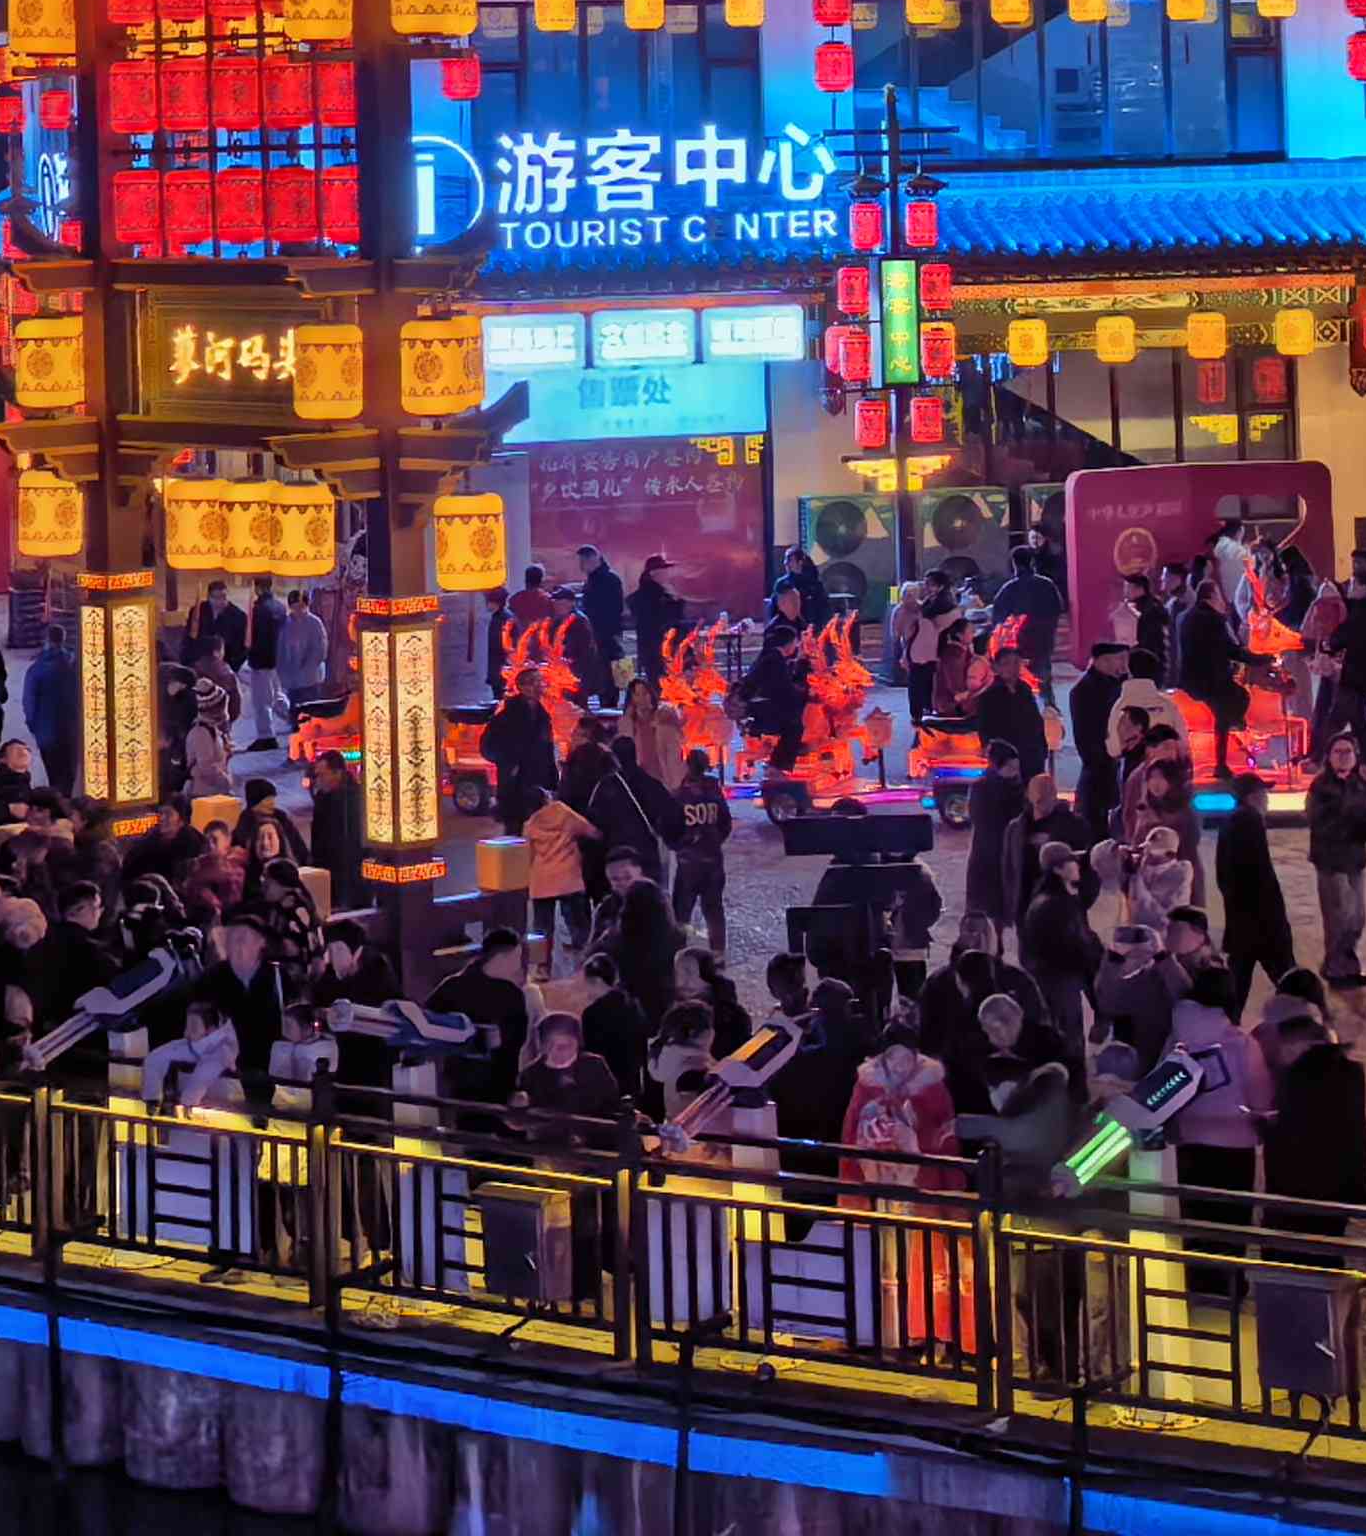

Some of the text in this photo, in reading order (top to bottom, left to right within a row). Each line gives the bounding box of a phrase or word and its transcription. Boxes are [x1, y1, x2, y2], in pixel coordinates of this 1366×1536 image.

[495, 123, 837, 213] 游客中心
[500, 216, 670, 250] TOURIST
